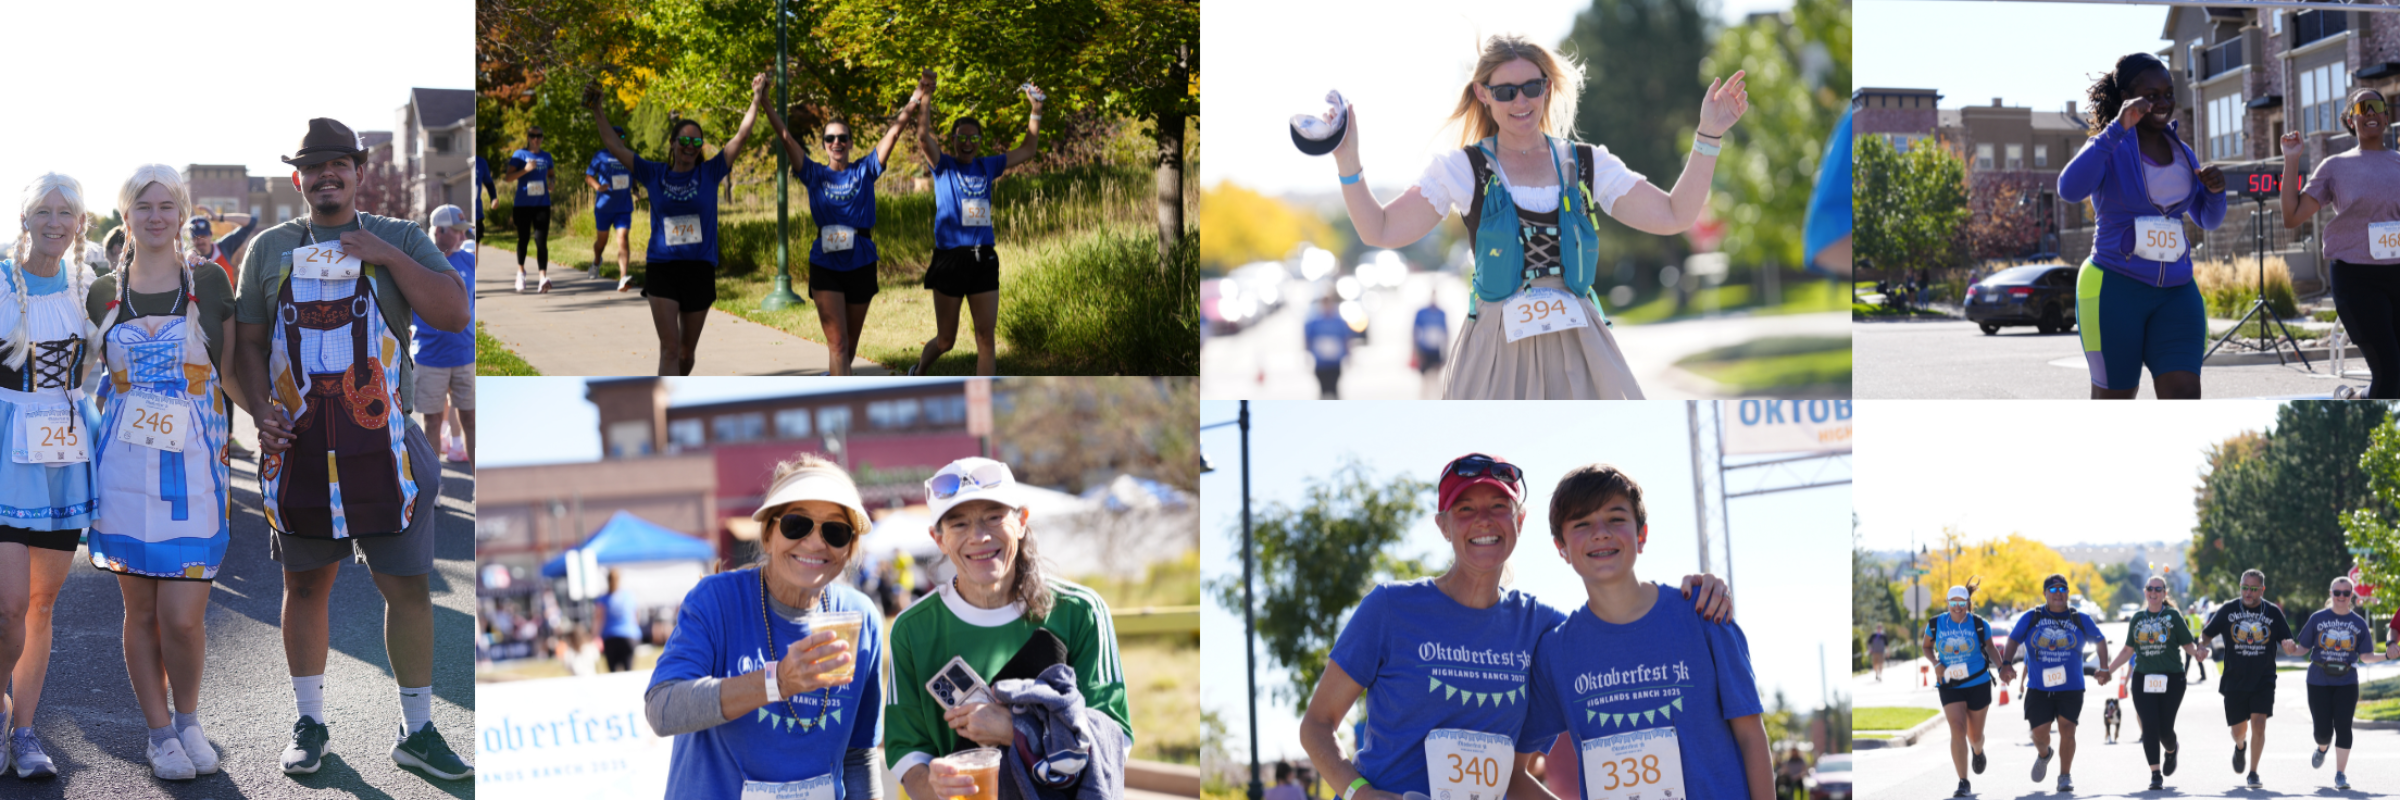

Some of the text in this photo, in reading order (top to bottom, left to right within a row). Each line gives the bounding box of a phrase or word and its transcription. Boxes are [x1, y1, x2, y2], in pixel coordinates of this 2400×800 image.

[968, 207, 986, 218] 522
[672, 224, 695, 237] 474
[827, 232, 847, 244] 473
[2146, 229, 2177, 249] 505
[306, 247, 349, 264] 247
[1517, 299, 1567, 324] 394
[132, 408, 174, 435] 246
[40, 426, 78, 447] 245
[1418, 641, 1515, 667] Oktoberfest
[1432, 668, 1480, 679] HIGHLANDS
[1483, 672, 1509, 681] RANCH
[1574, 660, 1690, 695] Oktoberfest 5k
[1949, 669, 1964, 679] 103
[2047, 671, 2063, 682] 102
[2149, 680, 2163, 688] 101
[793, 695, 818, 706] RANCH
[1587, 688, 1681, 707] HIGHLANDS RANCH 2025
[475, 708, 640, 755] oberfest
[475, 770, 525, 786] ANDS
[1447, 753, 1499, 788] 340
[1602, 754, 1662, 791] 338
